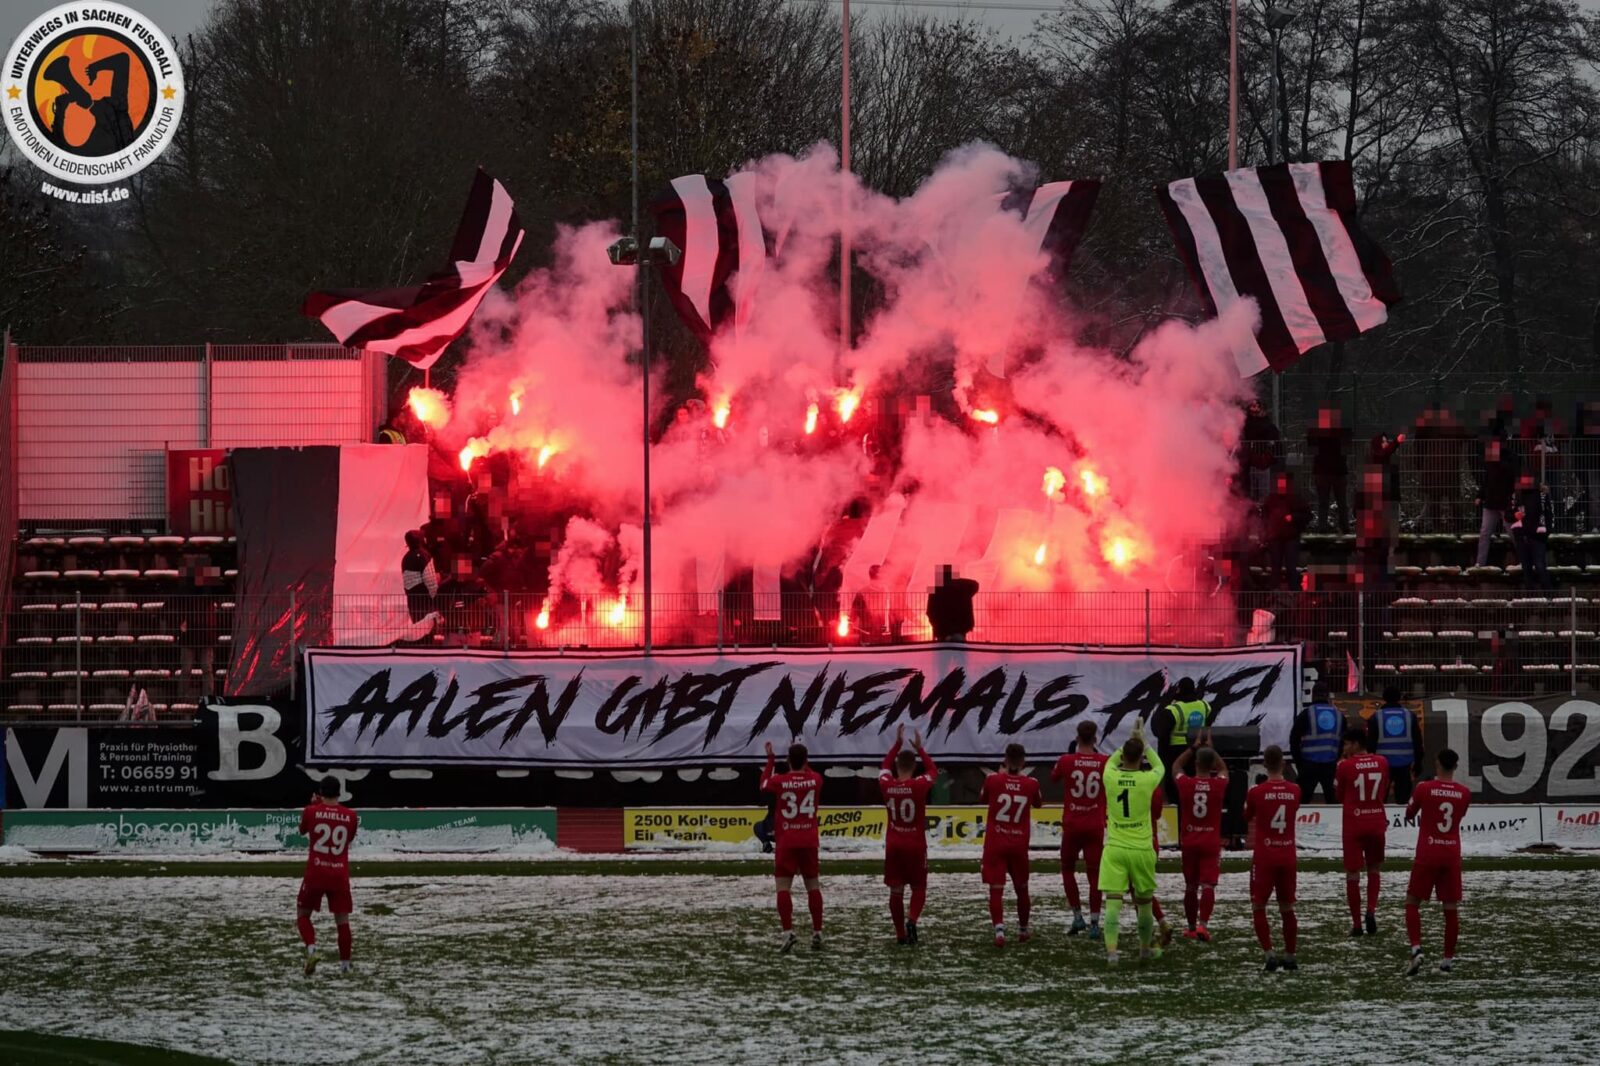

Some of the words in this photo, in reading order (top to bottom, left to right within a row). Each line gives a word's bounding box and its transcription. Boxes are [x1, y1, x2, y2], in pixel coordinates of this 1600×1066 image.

[318, 665, 587, 751] AALEN
[595, 661, 786, 753] GIBT
[736, 659, 1090, 747] NIEMALS
[1092, 657, 1267, 745] AF!
[100, 742, 129, 752] Praxis
[131, 742, 145, 752] für
[100, 752, 107, 761] &
[109, 752, 150, 761] Personal
[153, 752, 192, 763] Training
[100, 765, 116, 779] T:
[121, 765, 175, 779] 06659
[1070, 770, 1101, 799] 36
[1005, 782, 1022, 791] VOLZ
[1354, 772, 1383, 801] 17
[1430, 788, 1463, 799] HECKMANN
[315, 811, 350, 822] MAIELLA
[781, 789, 815, 819] 34
[886, 798, 916, 823] 10
[995, 793, 1029, 824] 27
[1116, 788, 1130, 818] 1
[1193, 792, 1208, 819] 8
[634, 815, 673, 826] 2500
[852, 822, 883, 837] 1971!
[1270, 804, 1287, 834] 4
[1436, 801, 1454, 833] 3
[313, 823, 349, 856] 29
